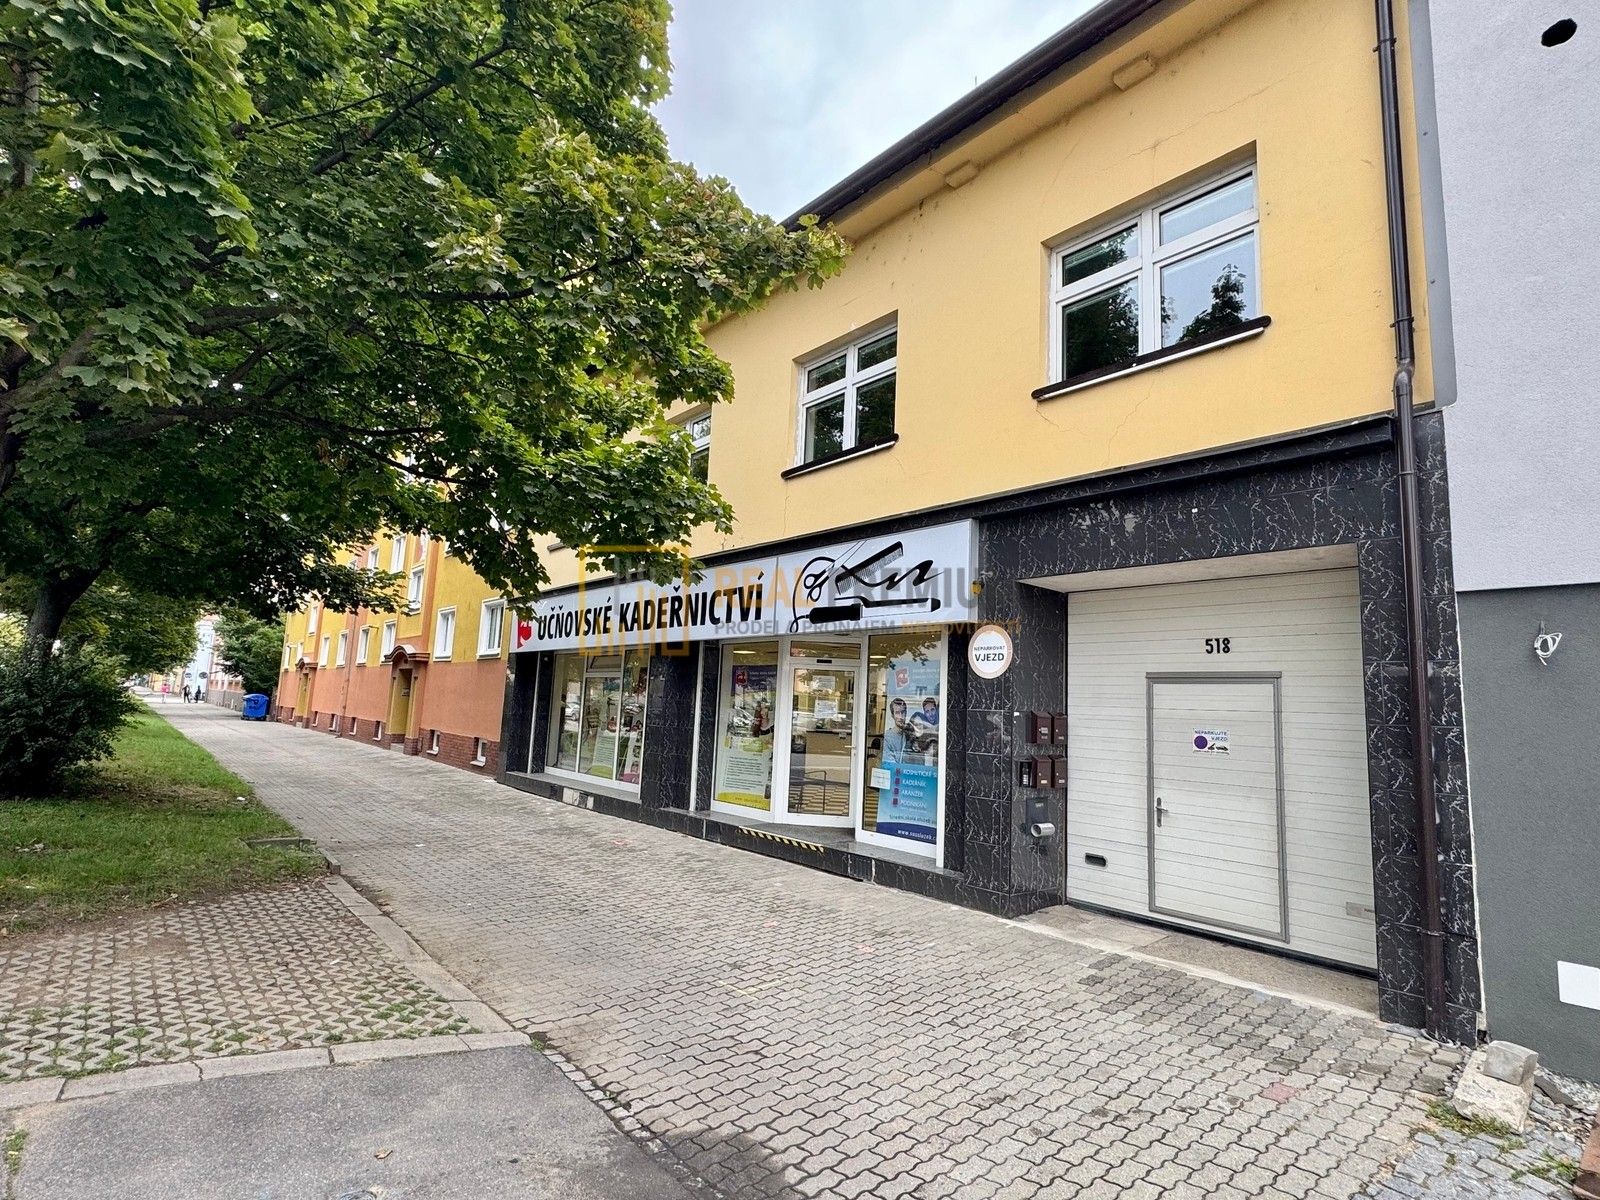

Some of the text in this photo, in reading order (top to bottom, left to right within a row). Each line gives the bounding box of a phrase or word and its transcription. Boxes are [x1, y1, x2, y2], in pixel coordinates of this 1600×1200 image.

[618, 570, 764, 633] KADEŘNICTVÍ
[1205, 637, 1231, 654] 518
[974, 652, 1005, 662] VJEZD
